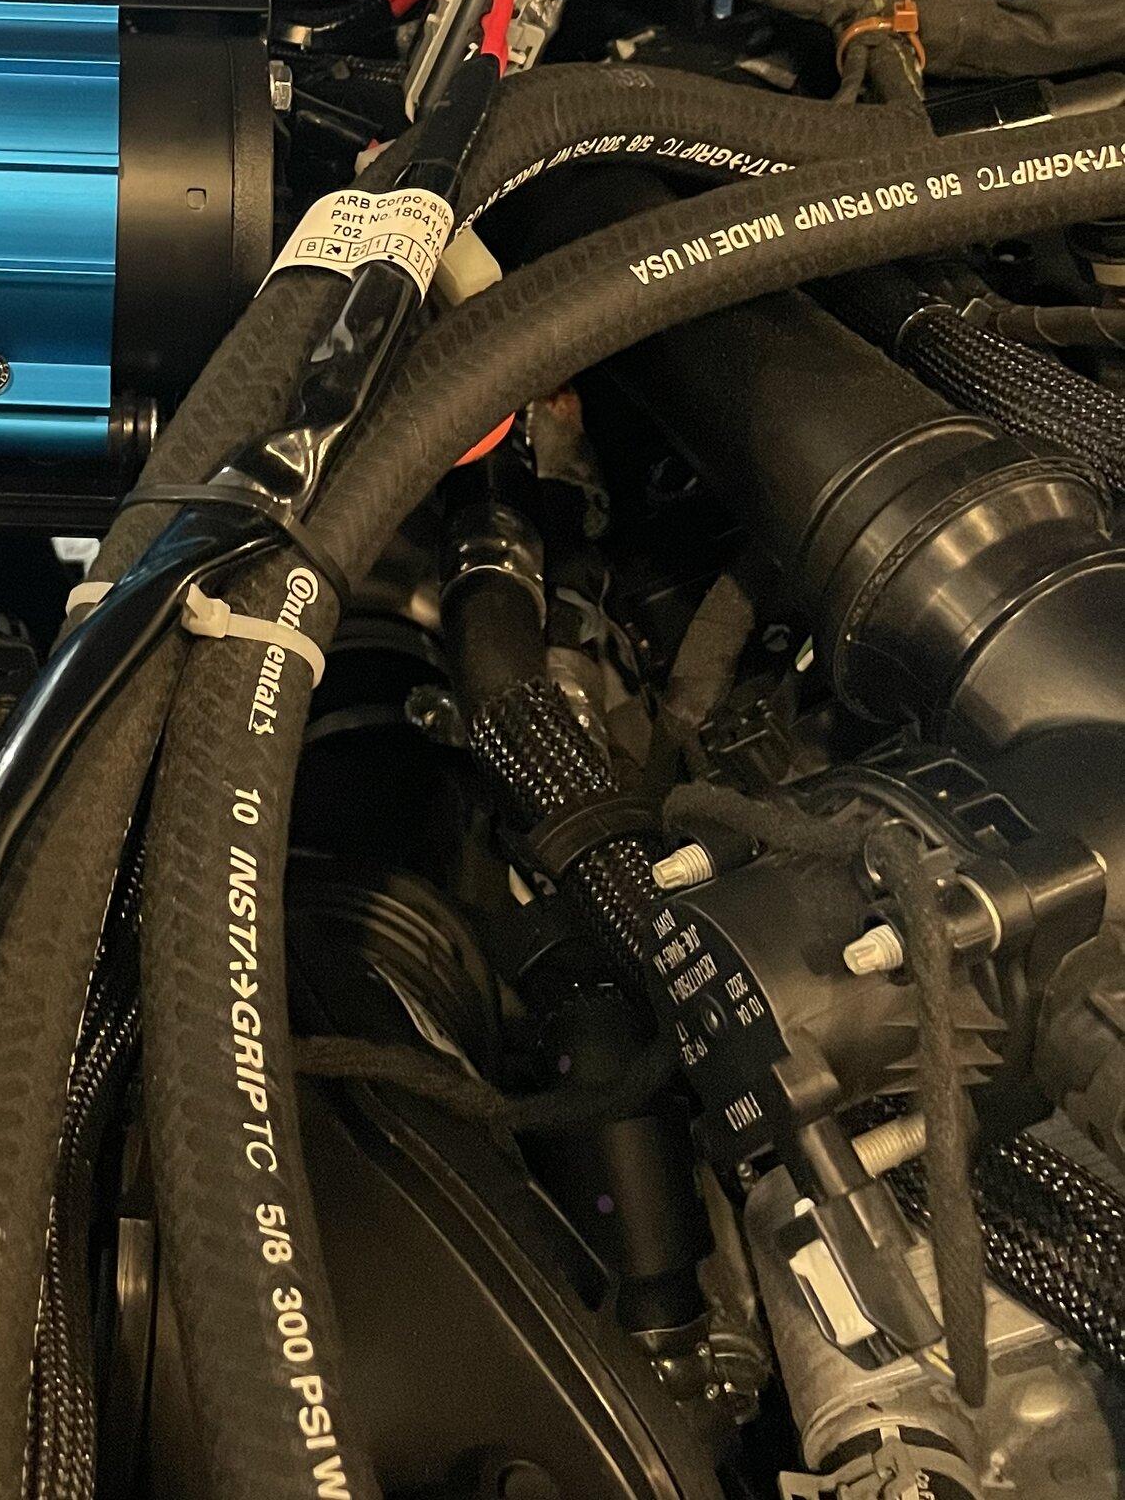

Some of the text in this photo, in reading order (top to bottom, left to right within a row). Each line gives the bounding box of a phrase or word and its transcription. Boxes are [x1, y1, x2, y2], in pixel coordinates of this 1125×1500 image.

[594, 134, 626, 154] 300
[926, 173, 963, 200] 5/8
[976, 165, 1011, 192] TC
[334, 195, 371, 209] ARB
[831, 191, 875, 221] PSI
[875, 181, 919, 211] 300
[331, 209, 365, 224] Part
[395, 207, 443, 239] 180414
[793, 201, 836, 230] WP
[333, 224, 363, 239] 702
[710, 213, 785, 256] MADE
[629, 248, 684, 285] USA
[682, 237, 713, 266] IN
[232, 787, 262, 826] 10
[724, 972, 749, 1001] 2021
[242, 1118, 278, 1173] TC
[255, 1203, 293, 1265] 5/8
[272, 1286, 314, 1362] 300
[290, 1375, 337, 1450] PSI
